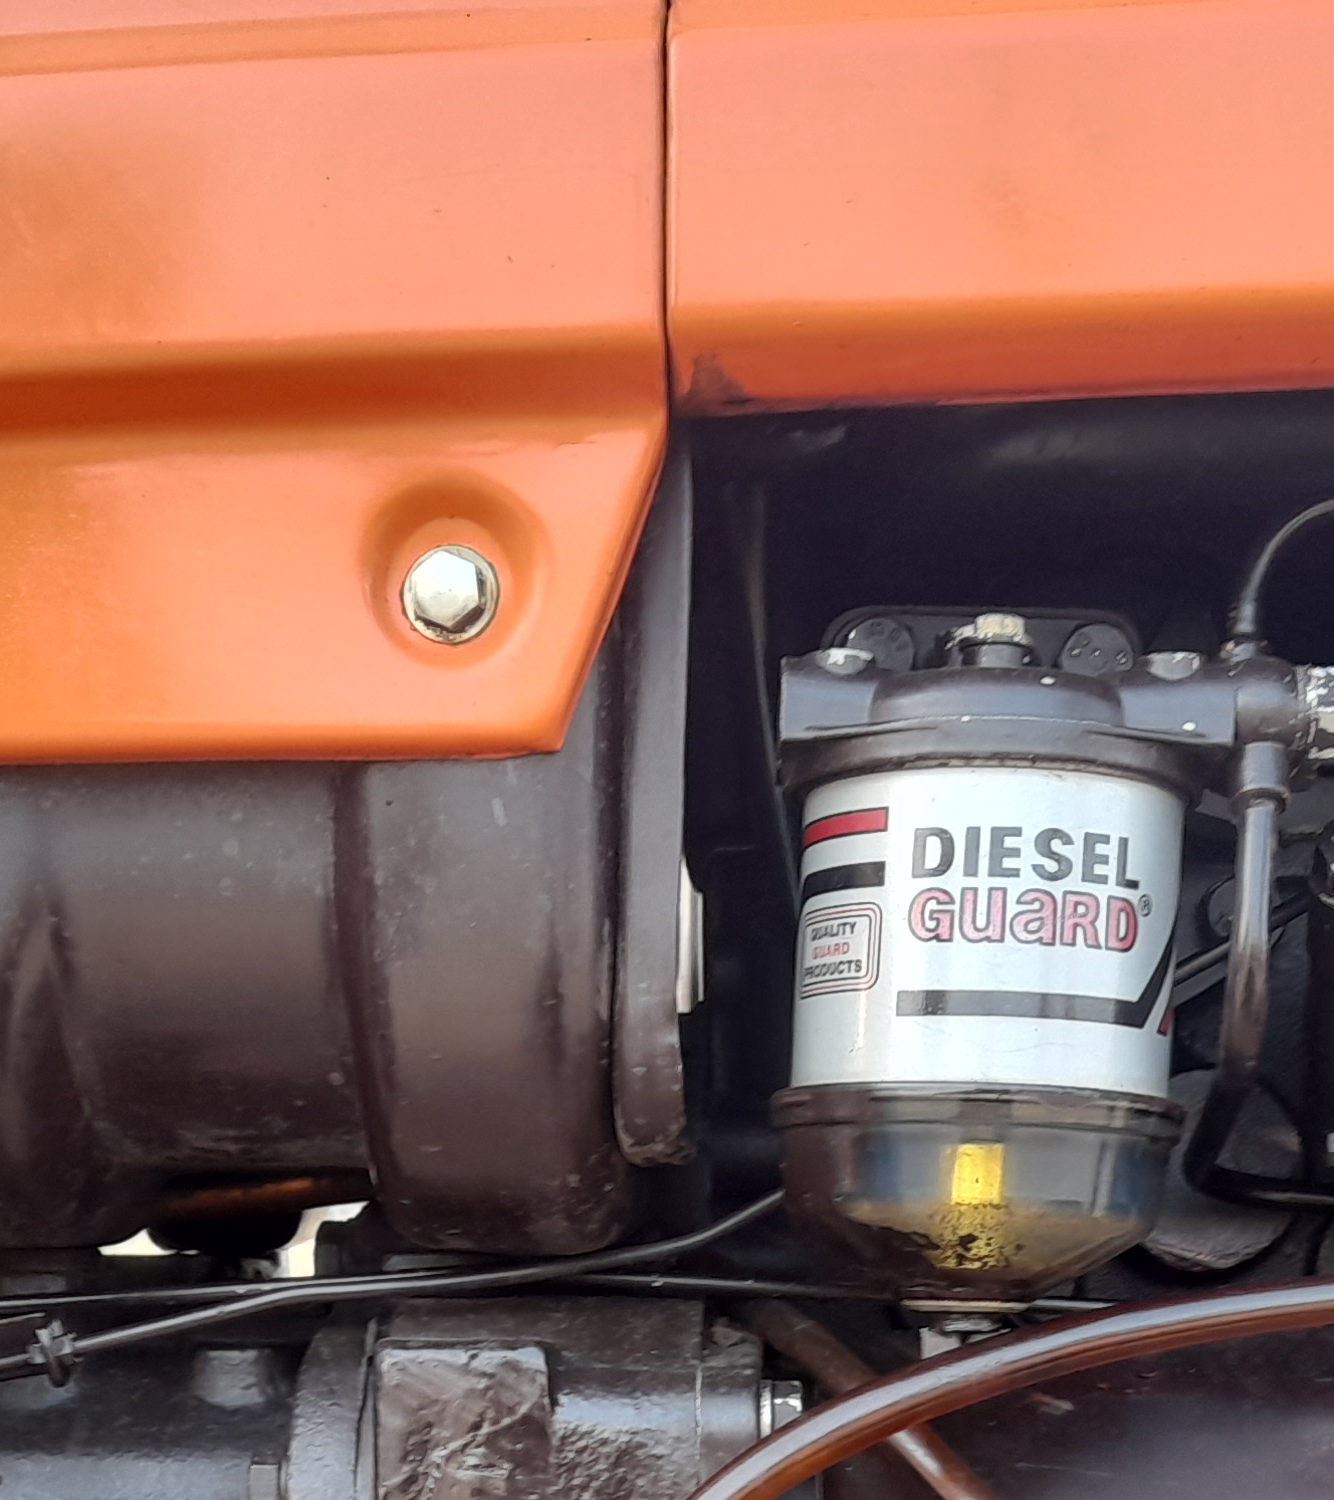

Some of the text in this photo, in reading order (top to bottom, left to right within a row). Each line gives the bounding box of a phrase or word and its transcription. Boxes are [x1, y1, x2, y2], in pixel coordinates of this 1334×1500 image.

[911, 825, 1140, 890] DIESEL
[811, 921, 857, 942] QUALITY
[812, 942, 850, 960] GUARD
[803, 959, 863, 980] PRODUCTS
